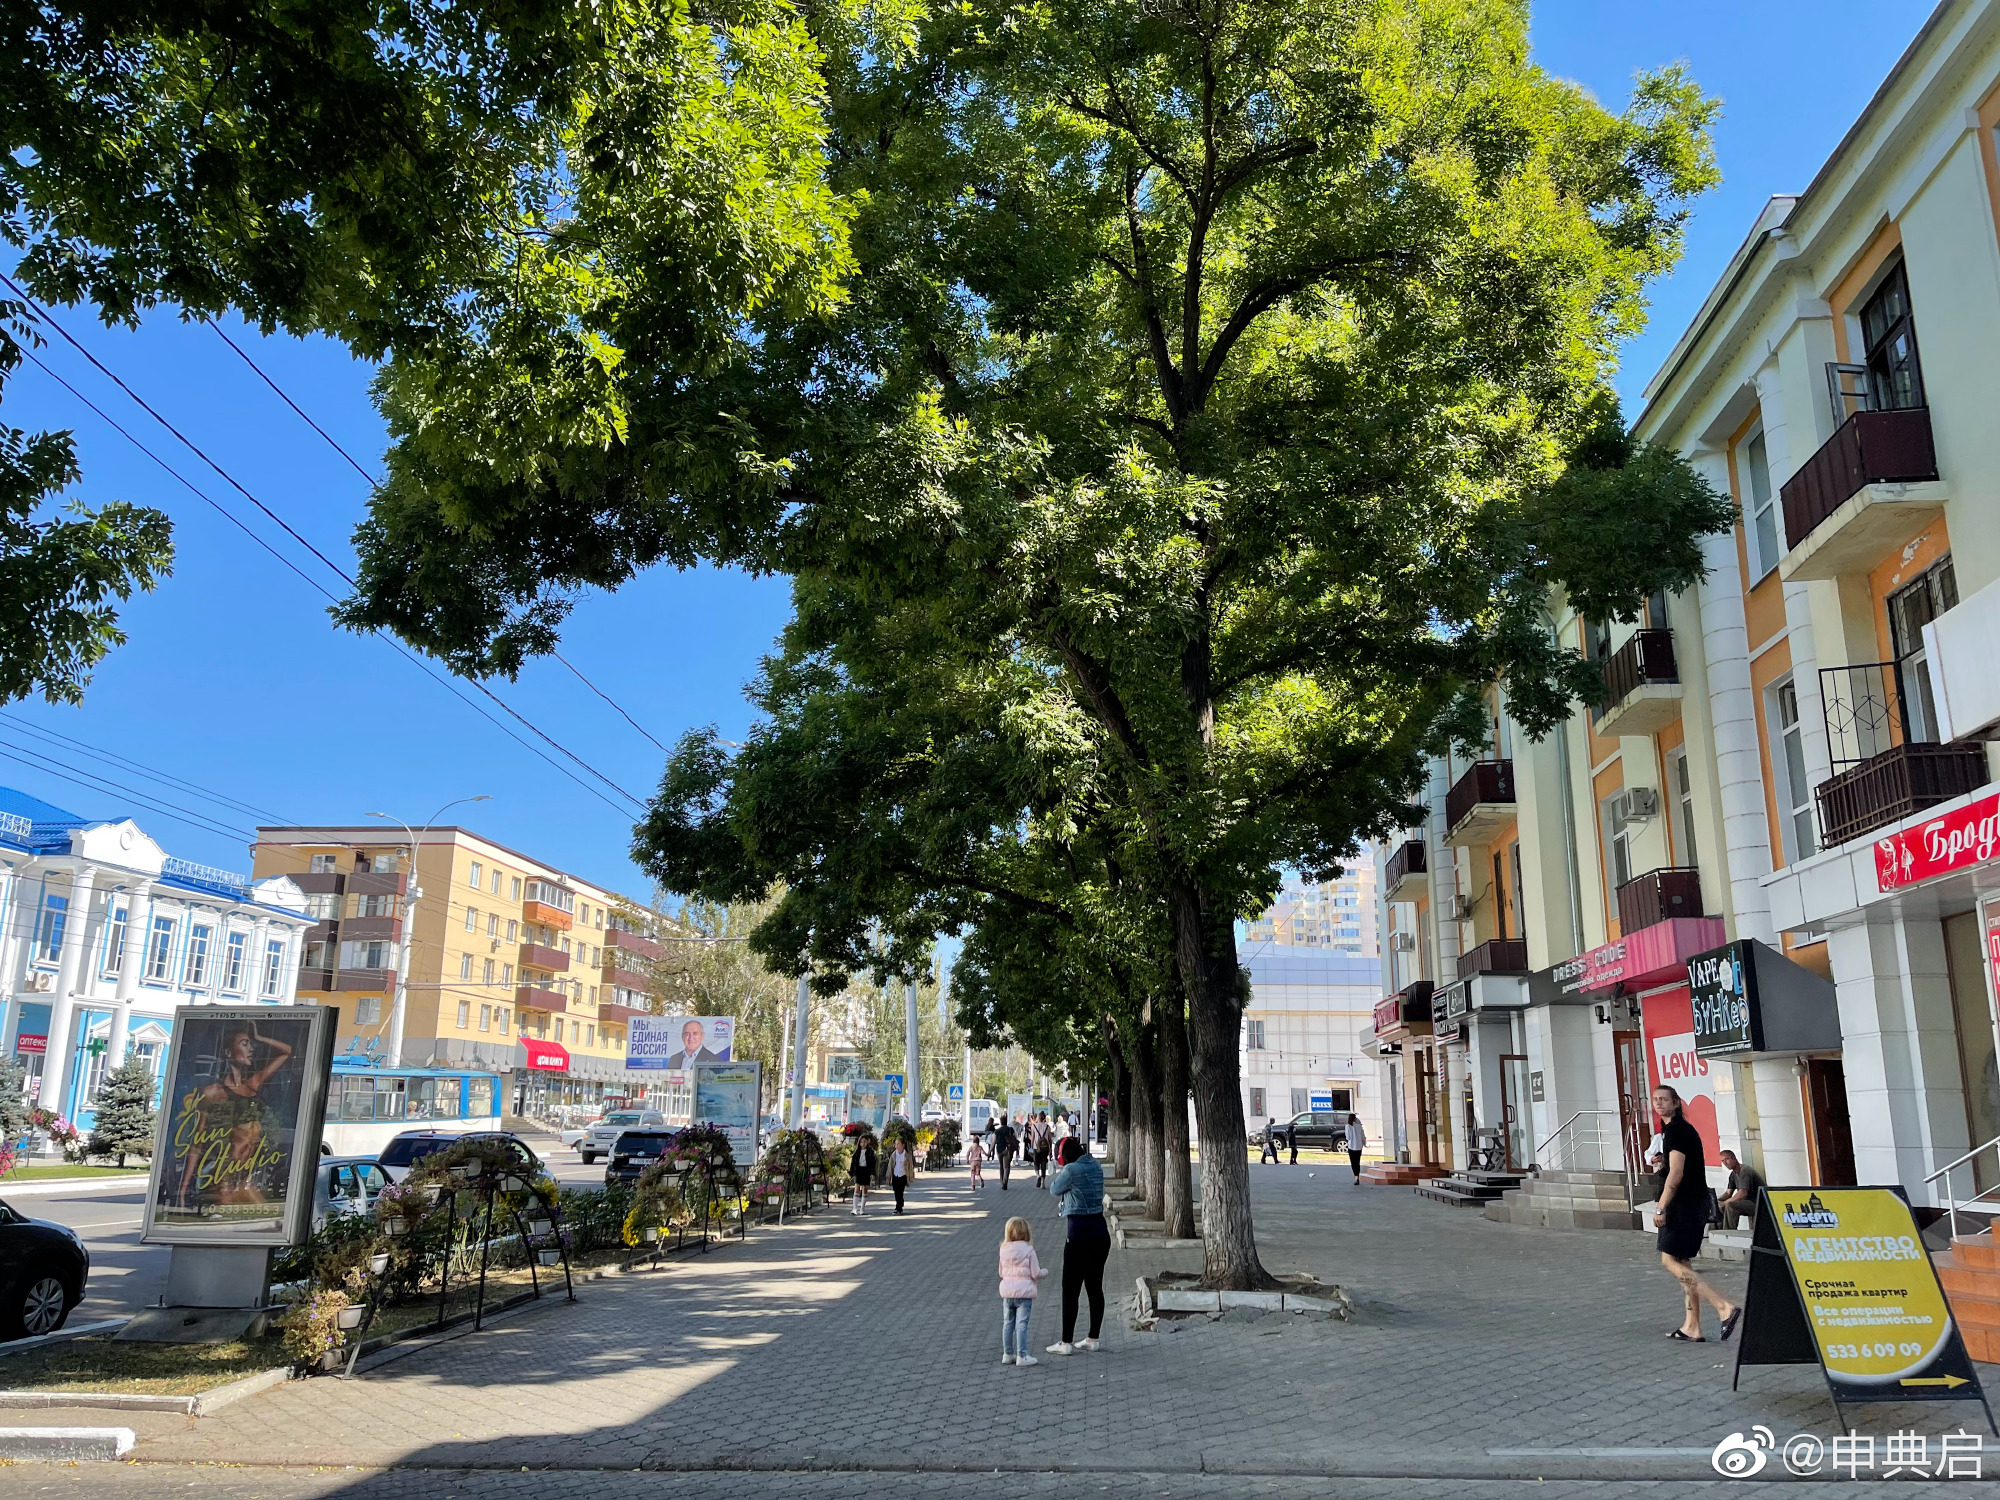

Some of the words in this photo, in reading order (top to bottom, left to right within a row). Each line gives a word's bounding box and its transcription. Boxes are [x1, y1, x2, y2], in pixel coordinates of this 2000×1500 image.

[1923, 795, 2000, 865] Брод
[1552, 959, 1587, 982] DRESS
[1594, 943, 1627, 967] CODE
[1596, 966, 1623, 981] одежда
[1687, 957, 1720, 989] VAPE
[632, 1019, 649, 1031] МЫ
[632, 1031, 668, 1043] ЕДИНАЯ
[631, 1043, 667, 1055] РОССИЯ
[174, 1110, 233, 1158] Sun
[197, 1135, 288, 1190] Studio
[1794, 1235, 1915, 1252] АГЕНТСТВО
[1795, 1249, 1921, 1263] НЕДВИЖИМОСТИ
[1804, 1279, 1856, 1290] Срочная
[1808, 1290, 1860, 1299] продажа
[1861, 1288, 1908, 1298] квартир
[1813, 1305, 1839, 1316] Все
[1840, 1306, 1904, 1318] операции
[1827, 1315, 1933, 1327] недвижимостью
[1826, 1344, 1858, 1358] 533
[1861, 1343, 1872, 1358] 6
[1873, 1343, 1896, 1357] 09
[1899, 1342, 1922, 1357] 09
